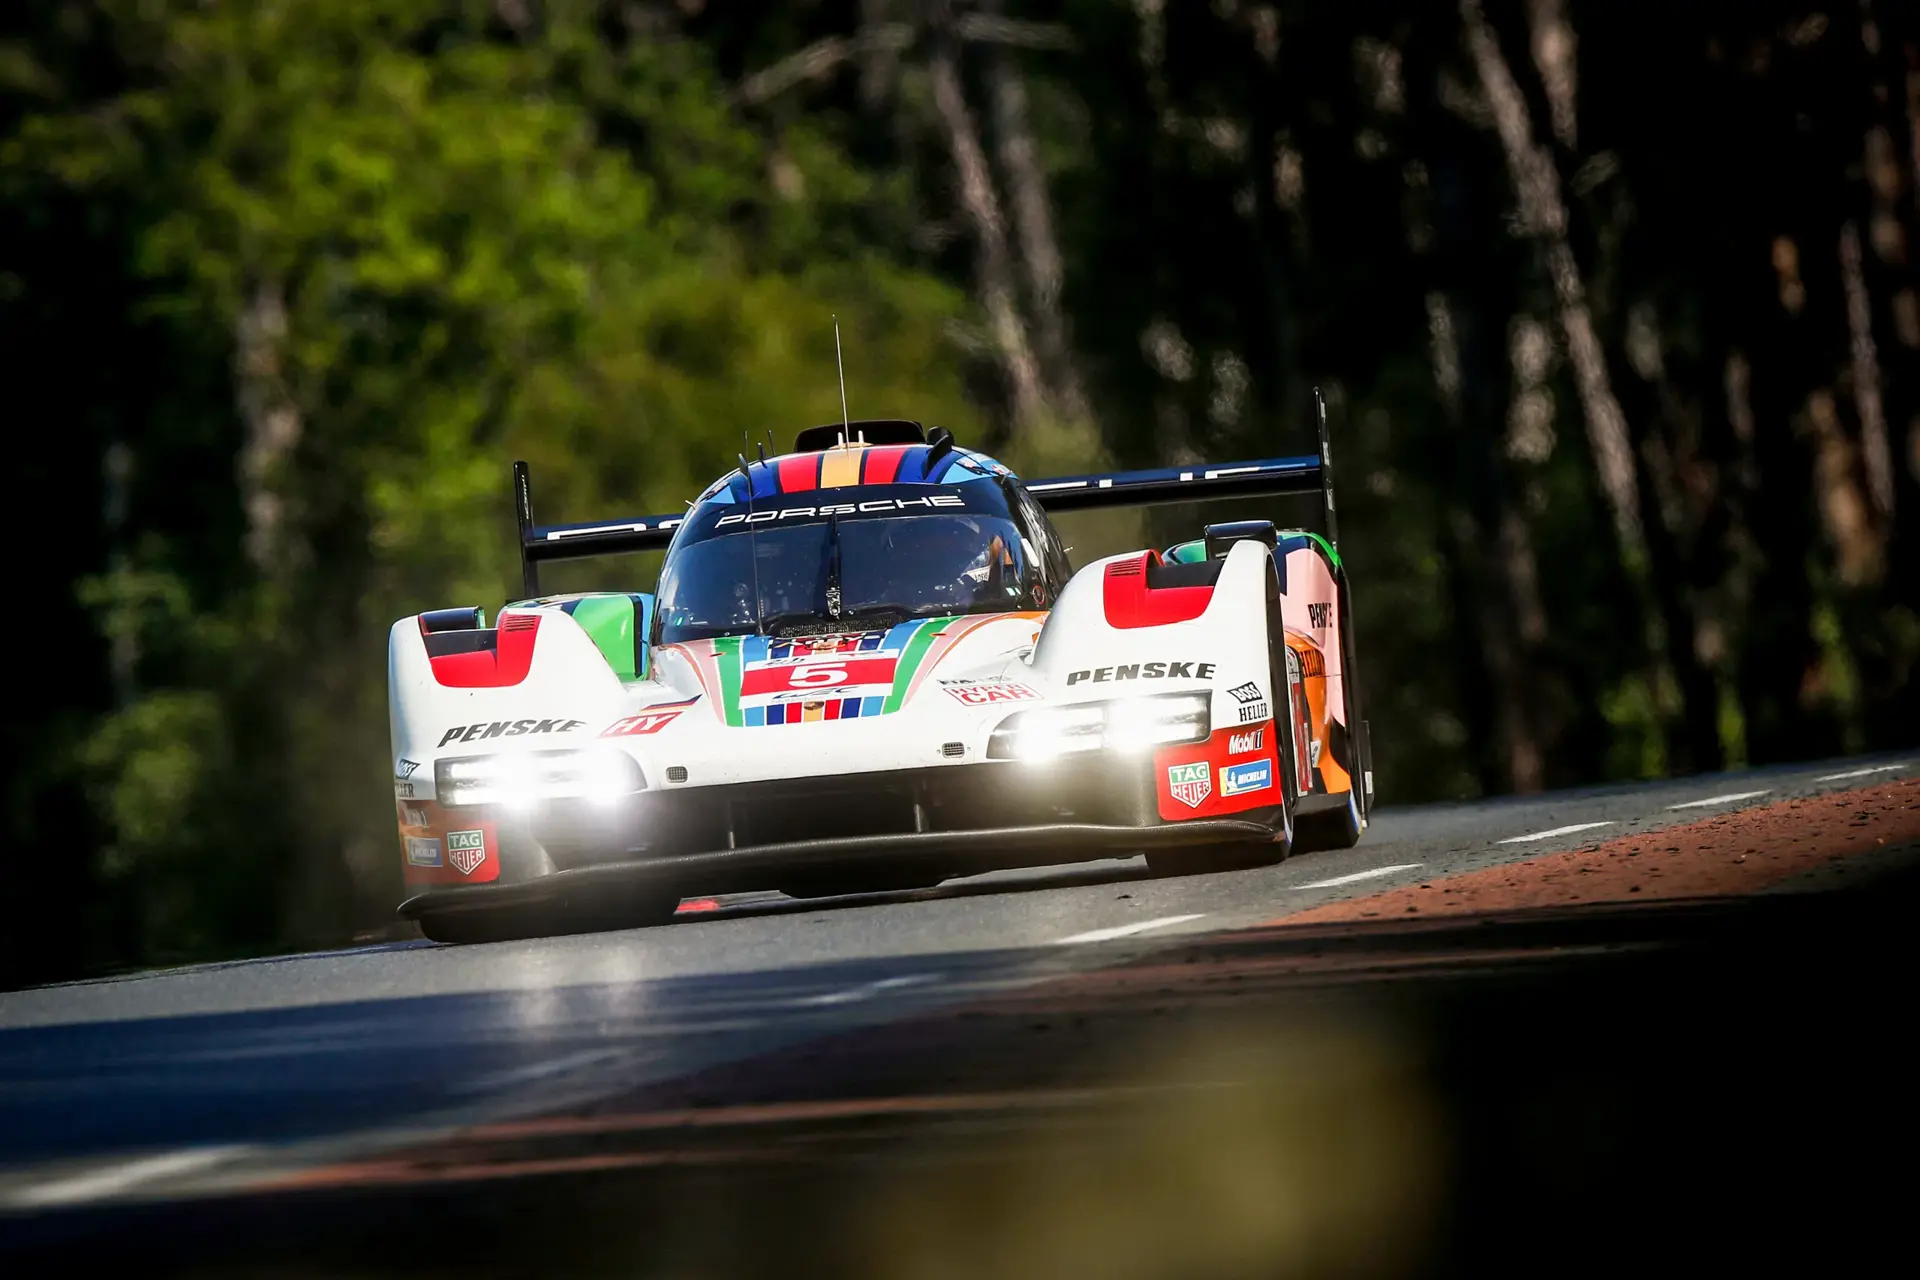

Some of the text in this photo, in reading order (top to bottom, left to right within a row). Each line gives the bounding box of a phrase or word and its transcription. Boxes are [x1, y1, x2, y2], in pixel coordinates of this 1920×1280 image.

[714, 495, 966, 529] PORSCHE
[788, 662, 848, 687] 5
[1067, 662, 1216, 686] PENSKE
[949, 684, 1025, 695] HYPER
[961, 689, 1037, 703] CAR
[1234, 684, 1260, 701] BOSS
[1239, 702, 1268, 722] HELLER
[437, 719, 587, 748] PENSKE
[604, 712, 672, 737] HY
[1229, 731, 1256, 755] Mobil
[1172, 766, 1207, 782] TAG
[1237, 769, 1268, 785] MICHELIN
[1172, 782, 1210, 805] HEUER
[449, 833, 481, 848] TAG
[451, 849, 483, 872] HEUER
